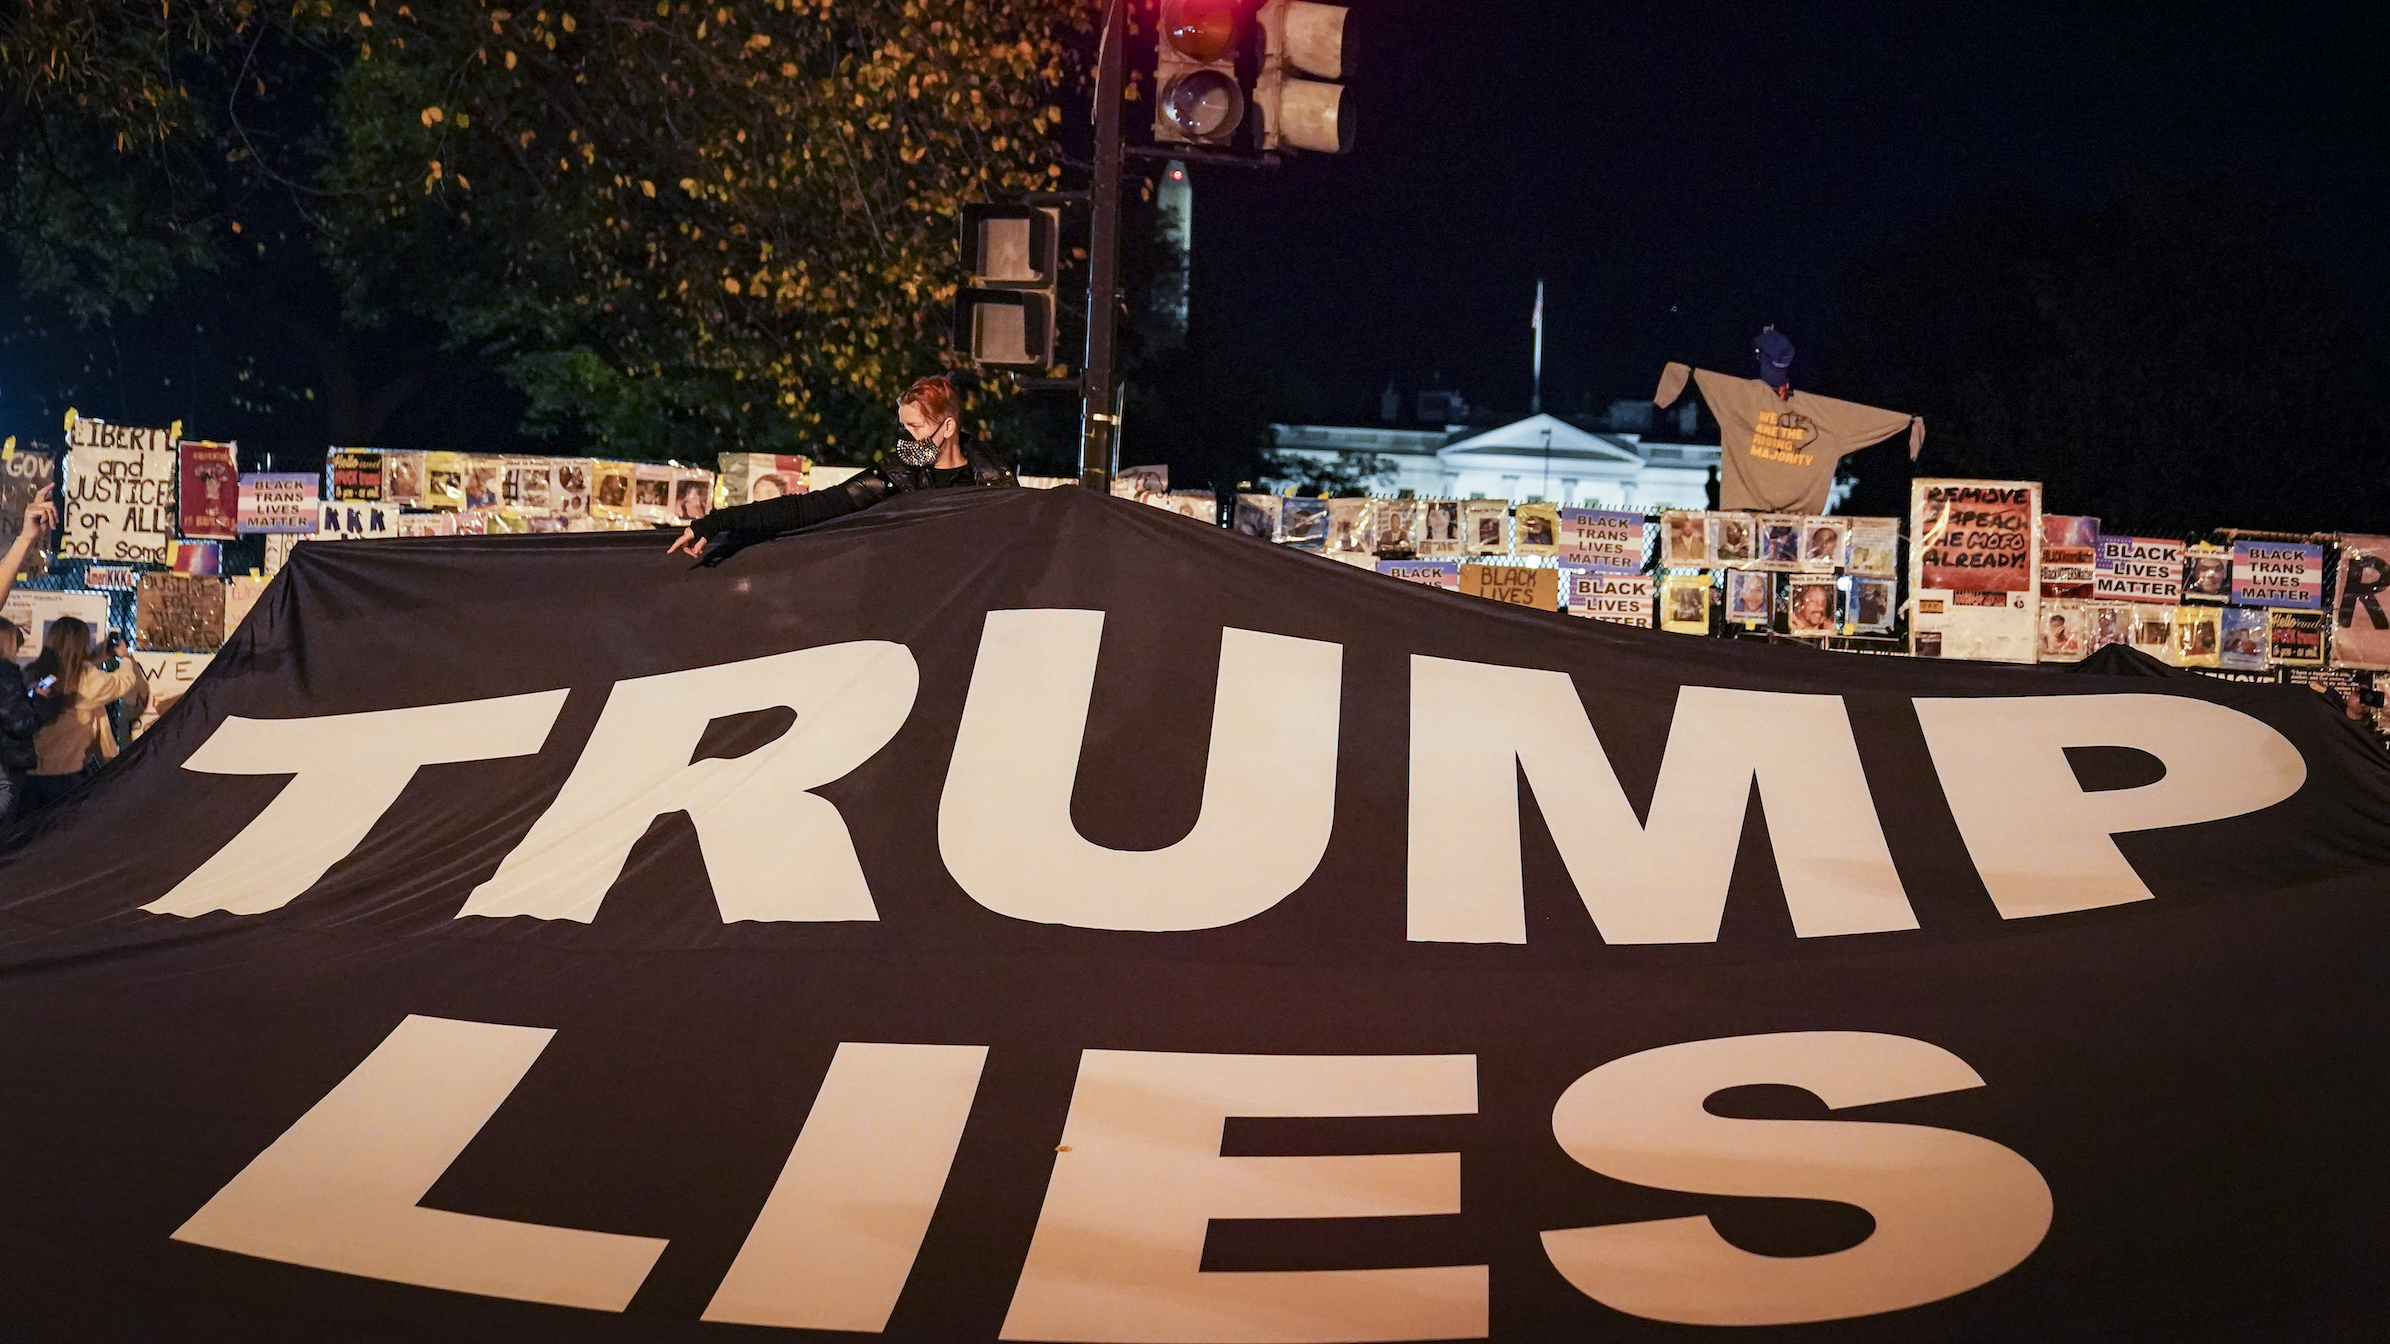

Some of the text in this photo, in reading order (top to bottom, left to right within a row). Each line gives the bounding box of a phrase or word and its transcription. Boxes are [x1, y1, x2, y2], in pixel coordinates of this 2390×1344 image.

[1759, 411, 1778, 425] WE
[1755, 424, 1805, 440] ARE THE
[1753, 434, 1793, 452] RISING
[1750, 445, 1815, 466] MAJORITY
[98, 453, 144, 477] and
[67, 475, 168, 506] JUSTICE
[255, 480, 304, 491] BLACK
[255, 493, 304, 503] TRANS
[1928, 487, 2029, 504] REMOVE
[257, 505, 299, 515] LIVES
[66, 503, 110, 528] for
[123, 507, 165, 533] ALL
[247, 517, 308, 528] MATTER
[1577, 515, 1630, 530] BLACK
[1577, 528, 1629, 542] TRANS
[1967, 531, 2025, 550] MOFO
[65, 532, 100, 557] not
[1579, 541, 1624, 555] LIVES
[1922, 550, 2027, 569] ALREADY!
[2106, 544, 2178, 561] BLACK
[2249, 549, 2305, 561] BLACK
[1568, 554, 1632, 568] MATTER
[2250, 562, 2305, 573] TRANS
[1391, 566, 1443, 579] BLACK
[1481, 568, 1537, 586] BLACK
[2114, 562, 2169, 578] LIVES
[1579, 581, 1647, 596] BLACK
[2097, 579, 2177, 596] MATTER
[2253, 575, 2300, 587] LIVES
[2242, 588, 2310, 601] MATTER
[1587, 599, 1641, 613] LIVES
[2271, 613, 2296, 627] Hello
[137, 660, 194, 681] WE
[137, 609, 2307, 945] TRUMP
[170, 1014, 2054, 1343] LIES
